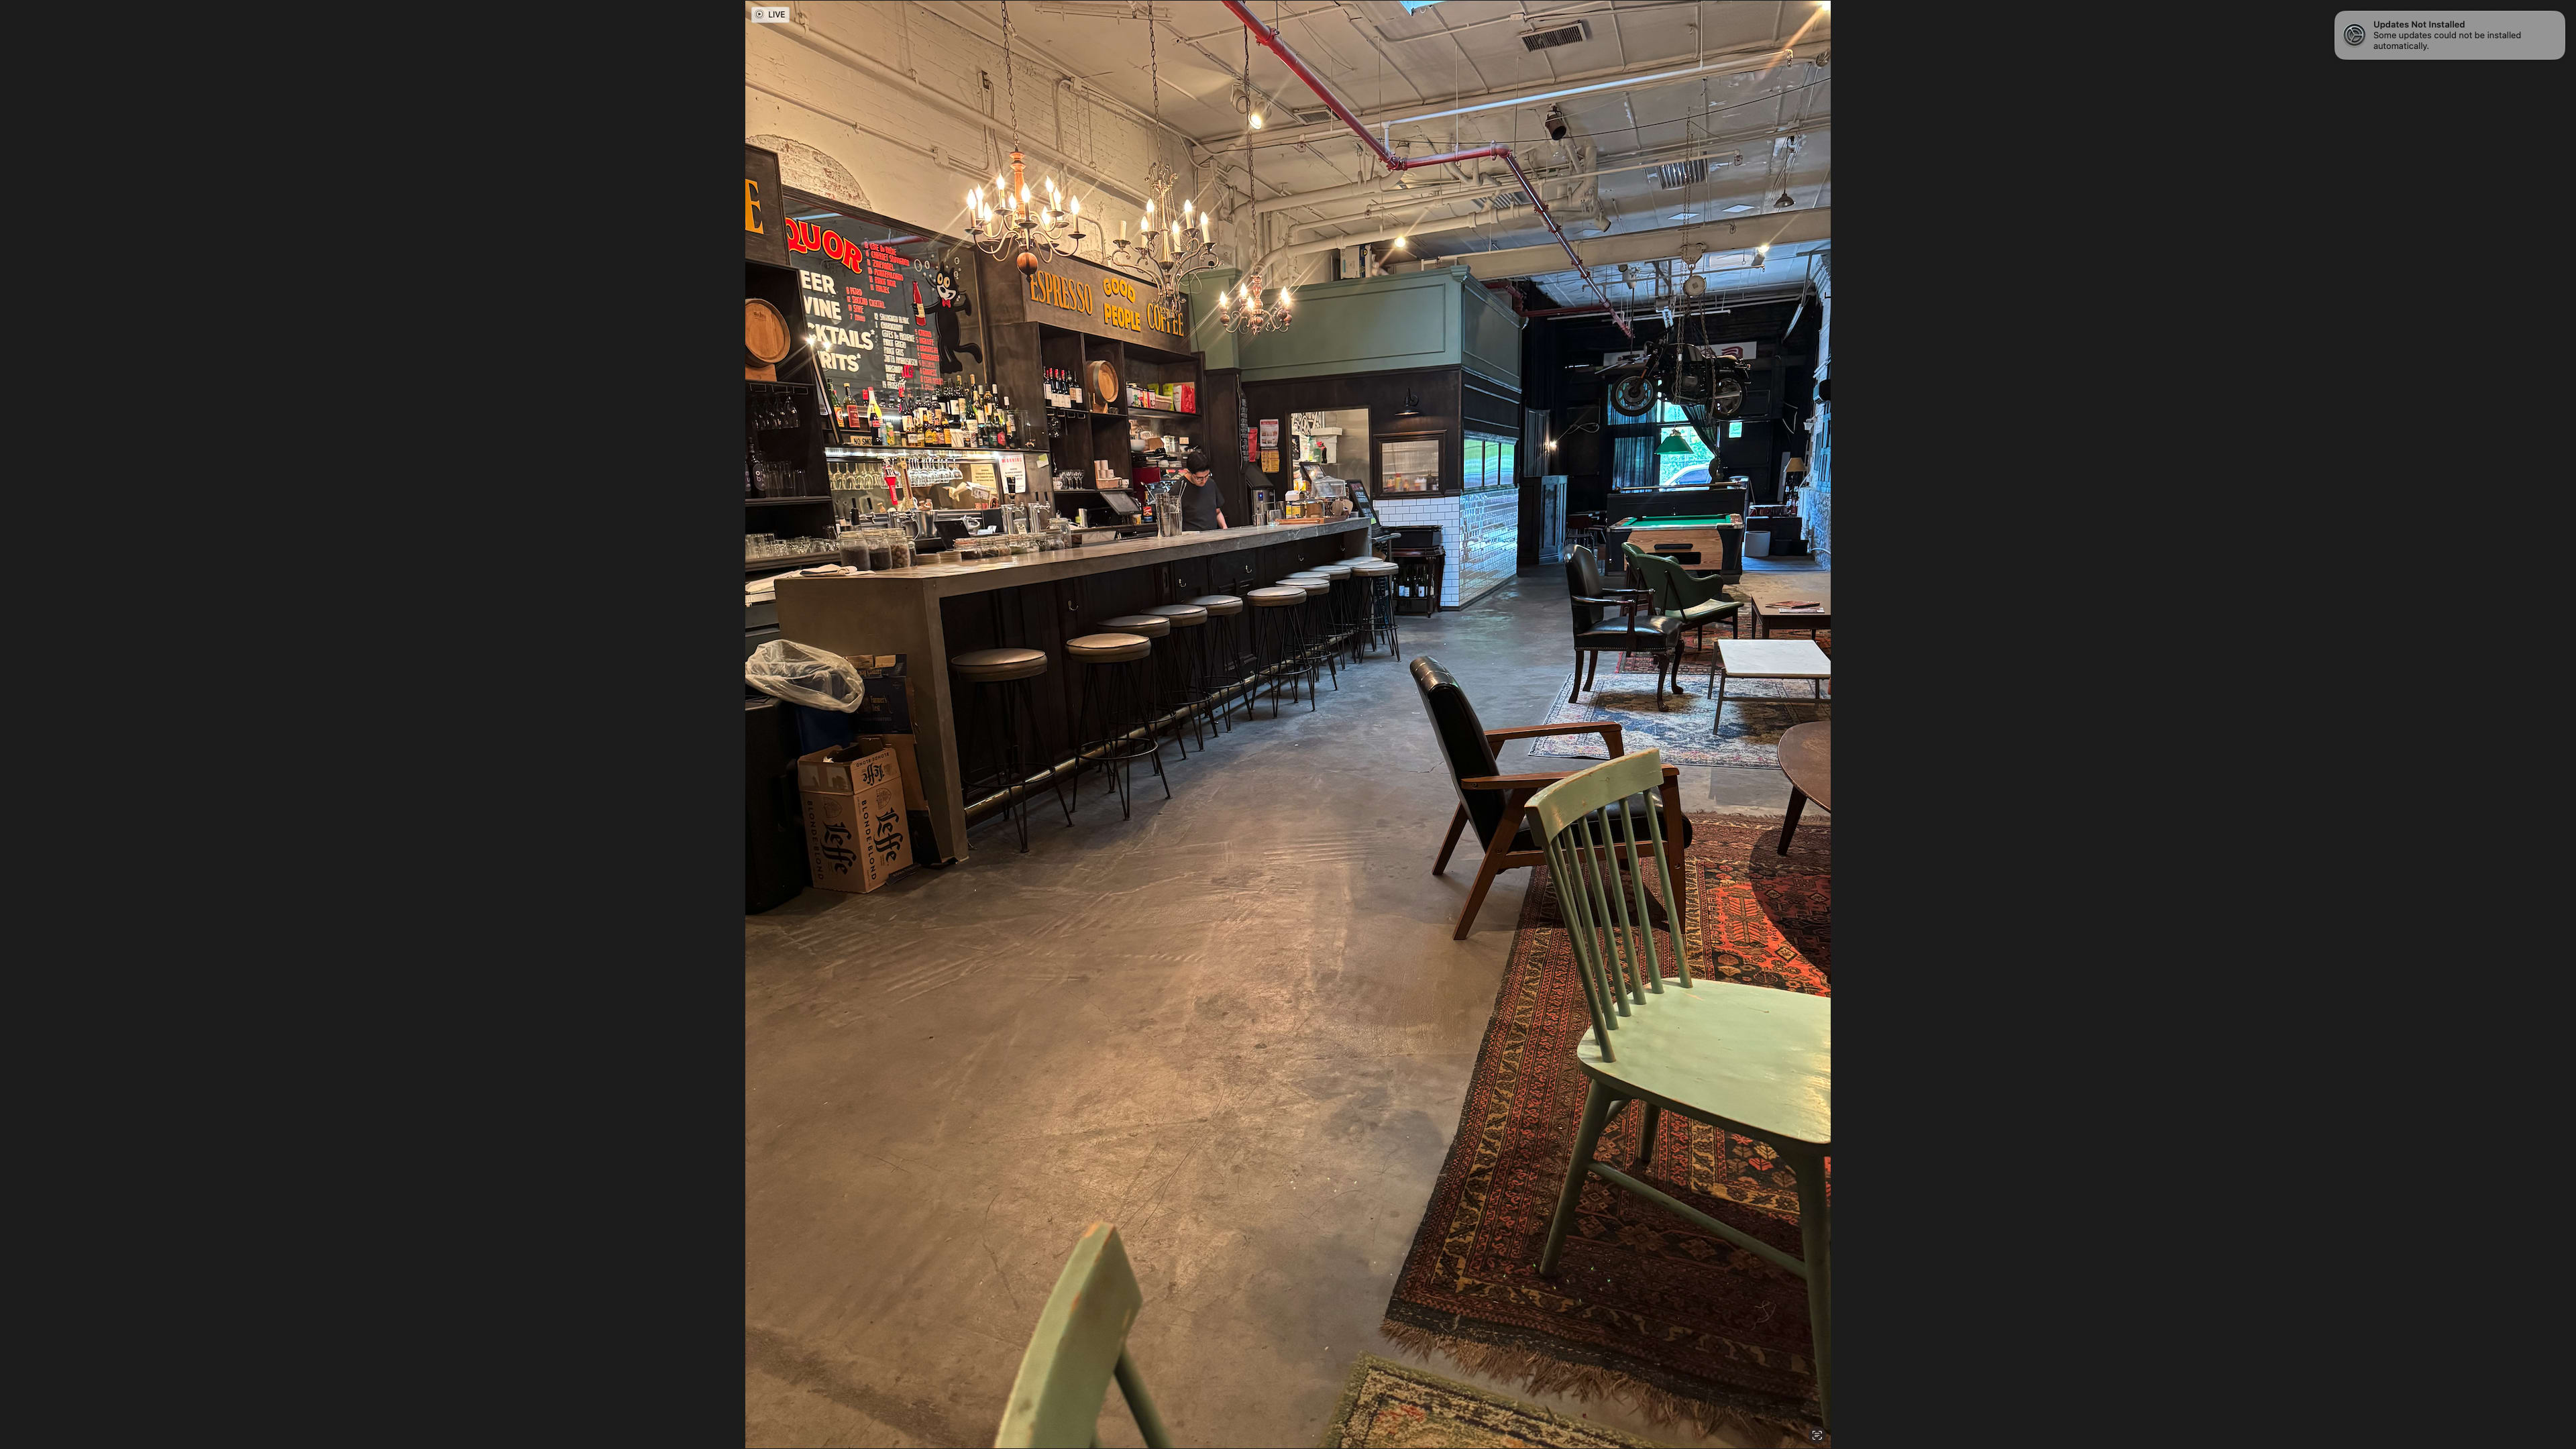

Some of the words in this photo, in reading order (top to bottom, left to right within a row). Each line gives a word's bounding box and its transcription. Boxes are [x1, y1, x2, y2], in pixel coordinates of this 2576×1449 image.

[1030, 270, 1093, 315] ESPRESSO
[1103, 277, 1136, 303] GOOD
[1104, 303, 1141, 331] PEOPLE
[861, 763, 885, 786] Leffe
[820, 821, 857, 875] Leffe
[873, 806, 904, 862] Leffe
